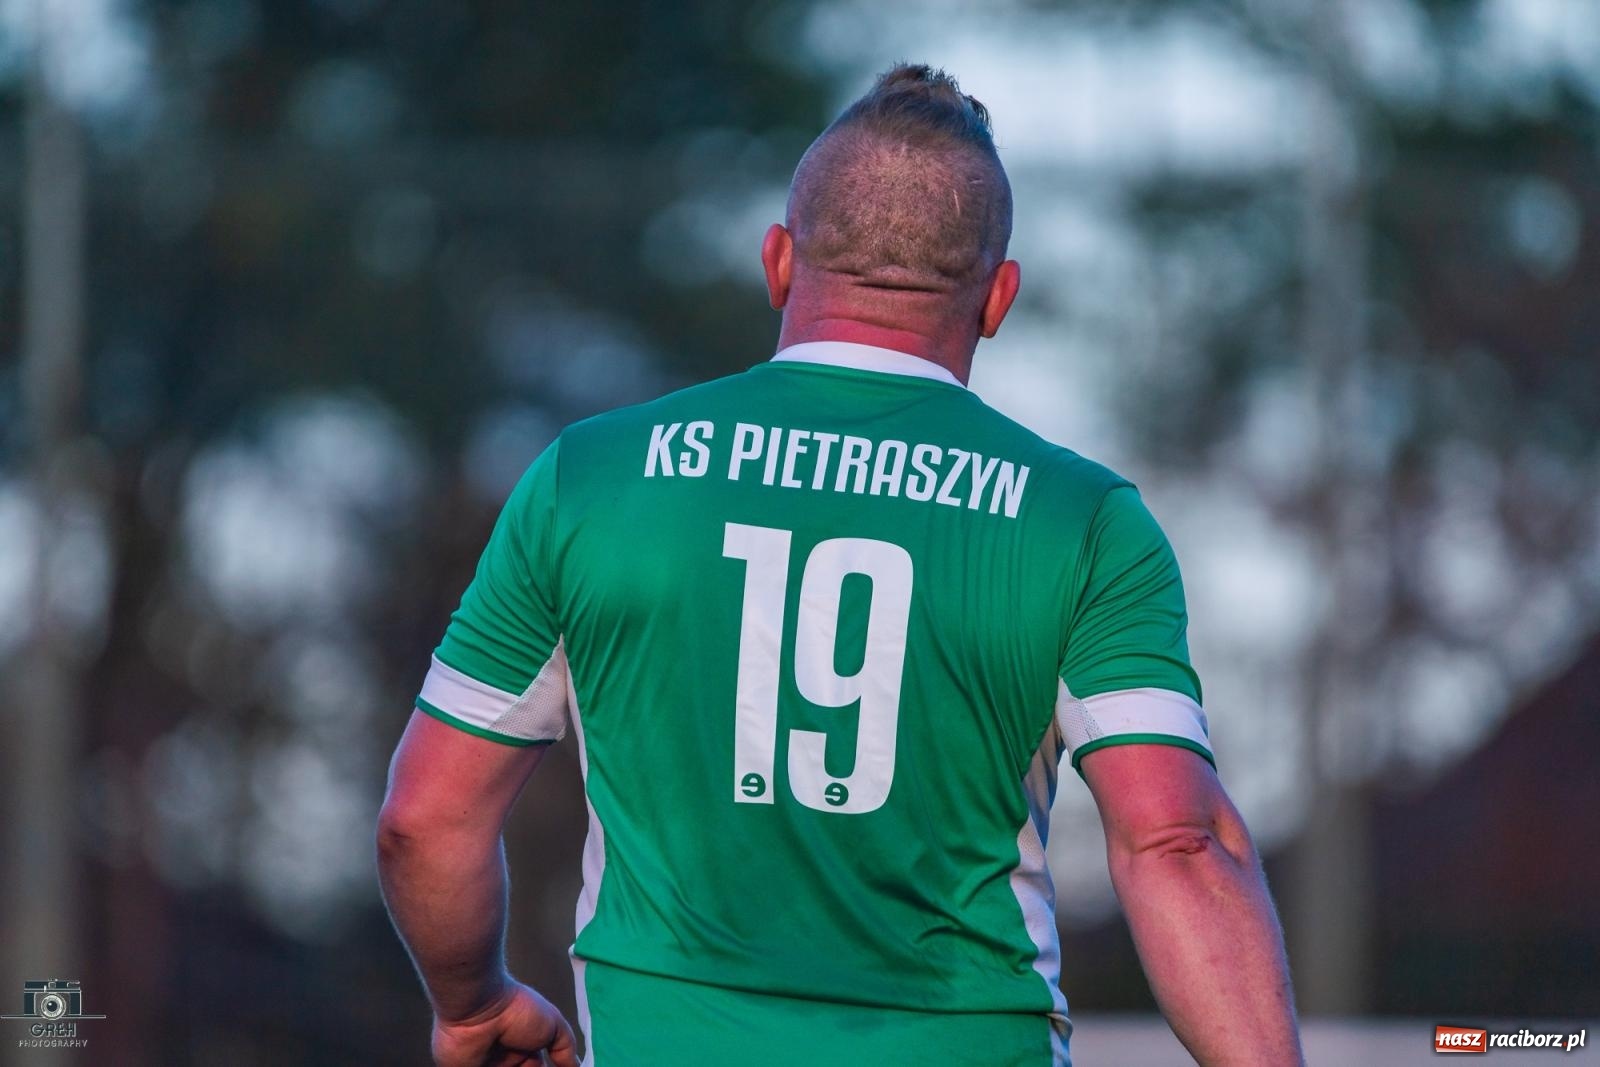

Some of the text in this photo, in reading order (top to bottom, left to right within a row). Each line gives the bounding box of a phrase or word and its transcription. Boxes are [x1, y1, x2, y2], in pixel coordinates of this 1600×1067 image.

[644, 421, 1030, 519] KS PIETRASZYN
[722, 522, 914, 815] 19
